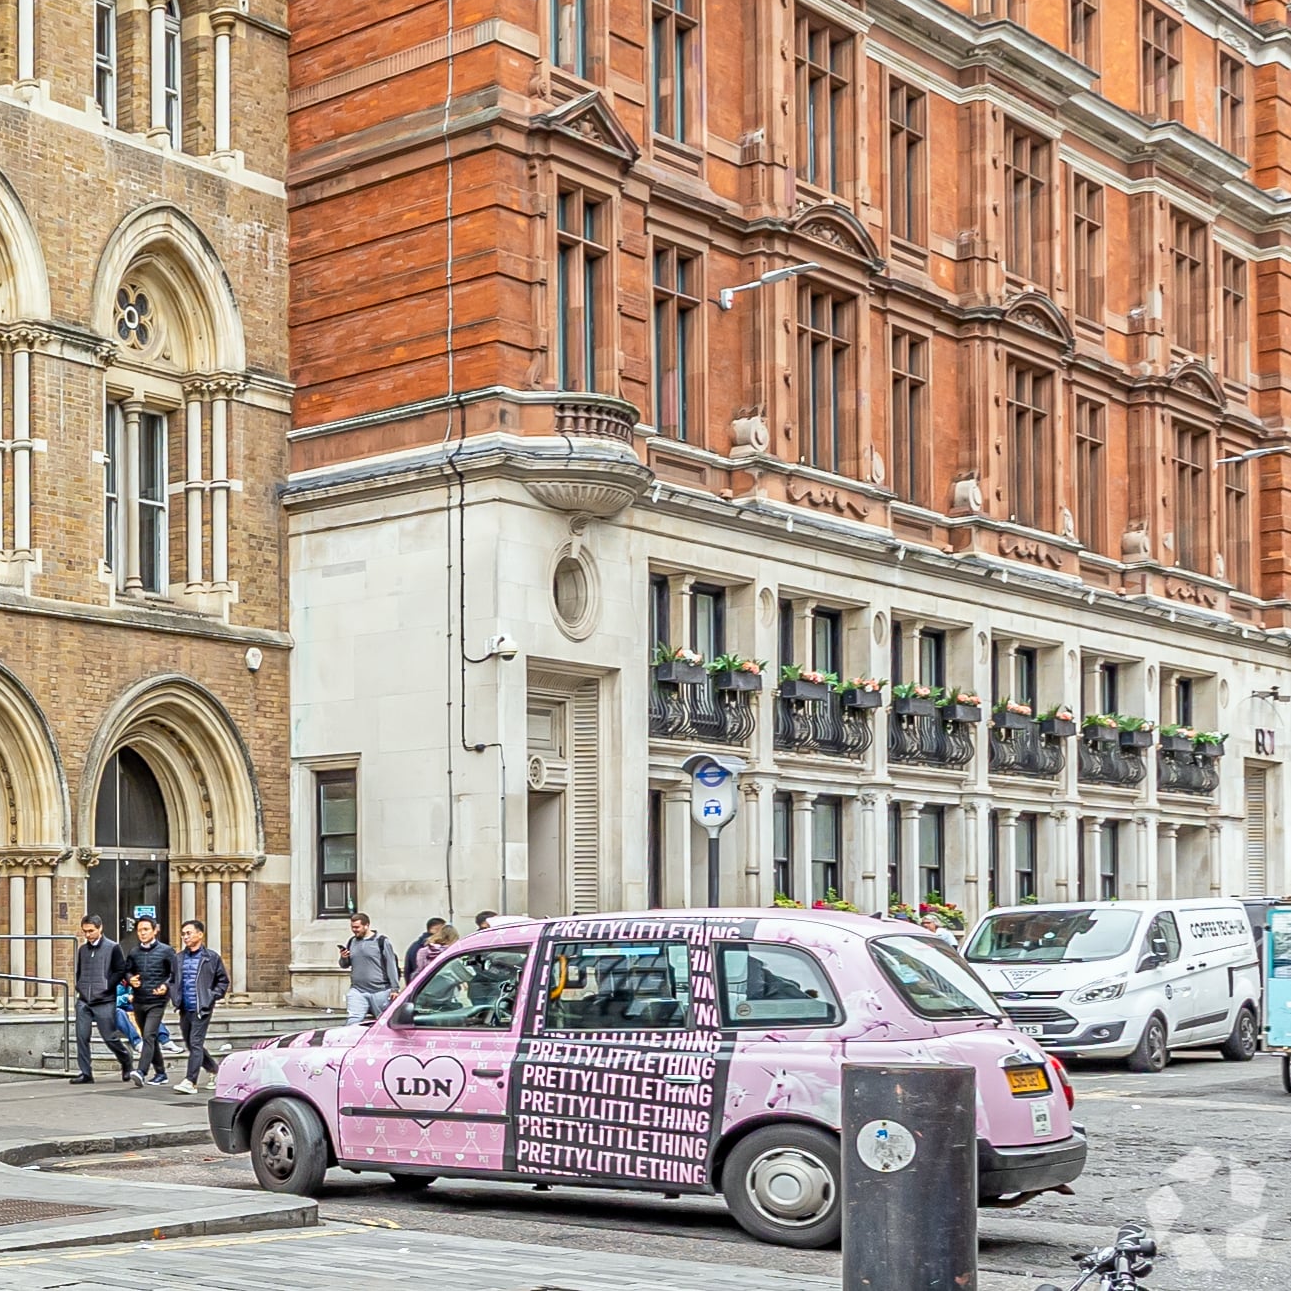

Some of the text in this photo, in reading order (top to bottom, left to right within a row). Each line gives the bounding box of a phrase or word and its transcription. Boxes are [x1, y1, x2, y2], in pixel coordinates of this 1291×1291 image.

[526, 1040, 716, 1080] PRETTYLITTLETHING
[396, 1077, 453, 1097] LDN
[520, 1089, 710, 1134] PRETTYLITTLETHING
[519, 1115, 708, 1160] PRETTYLITTLETHING
[517, 1139, 706, 1185] PRETTYLITTLETHING
